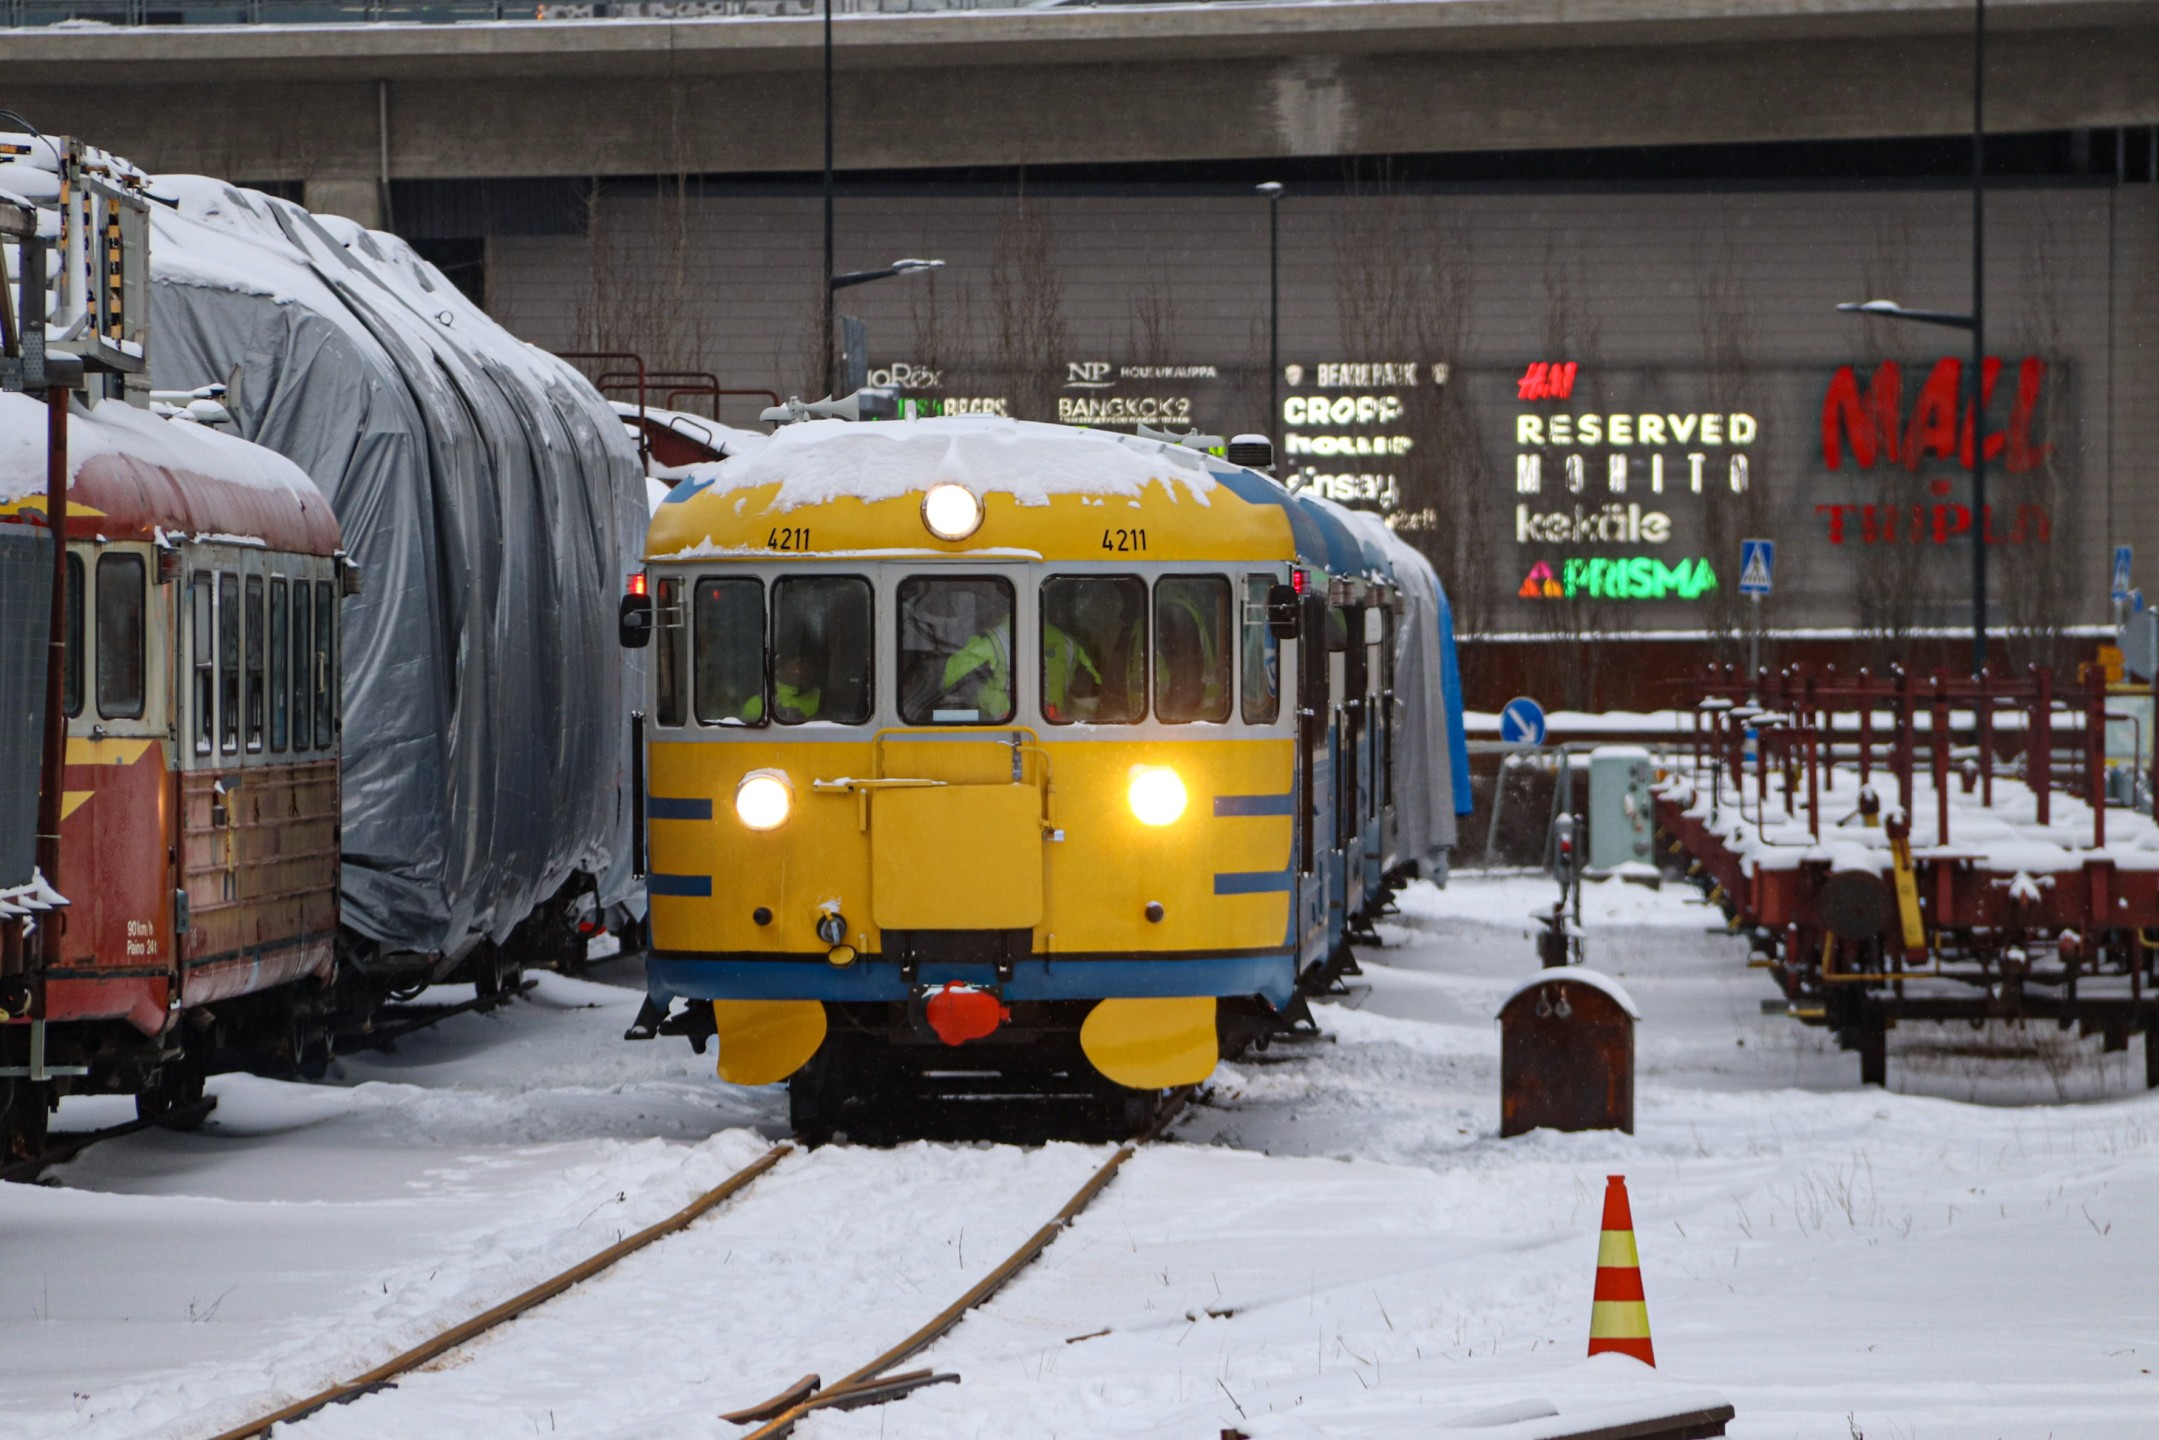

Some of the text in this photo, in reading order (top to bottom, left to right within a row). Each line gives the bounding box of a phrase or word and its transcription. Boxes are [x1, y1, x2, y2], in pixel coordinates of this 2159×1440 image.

[1066, 362, 1112, 382] NP
[1284, 396, 1403, 424] CROPP
[1517, 413, 1757, 445] RESERVED
[1517, 453, 1749, 494] MOHITO
[767, 528, 810, 550] 4211
[1102, 529, 1147, 551] 4211
[1564, 557, 1718, 599] PRISMA
